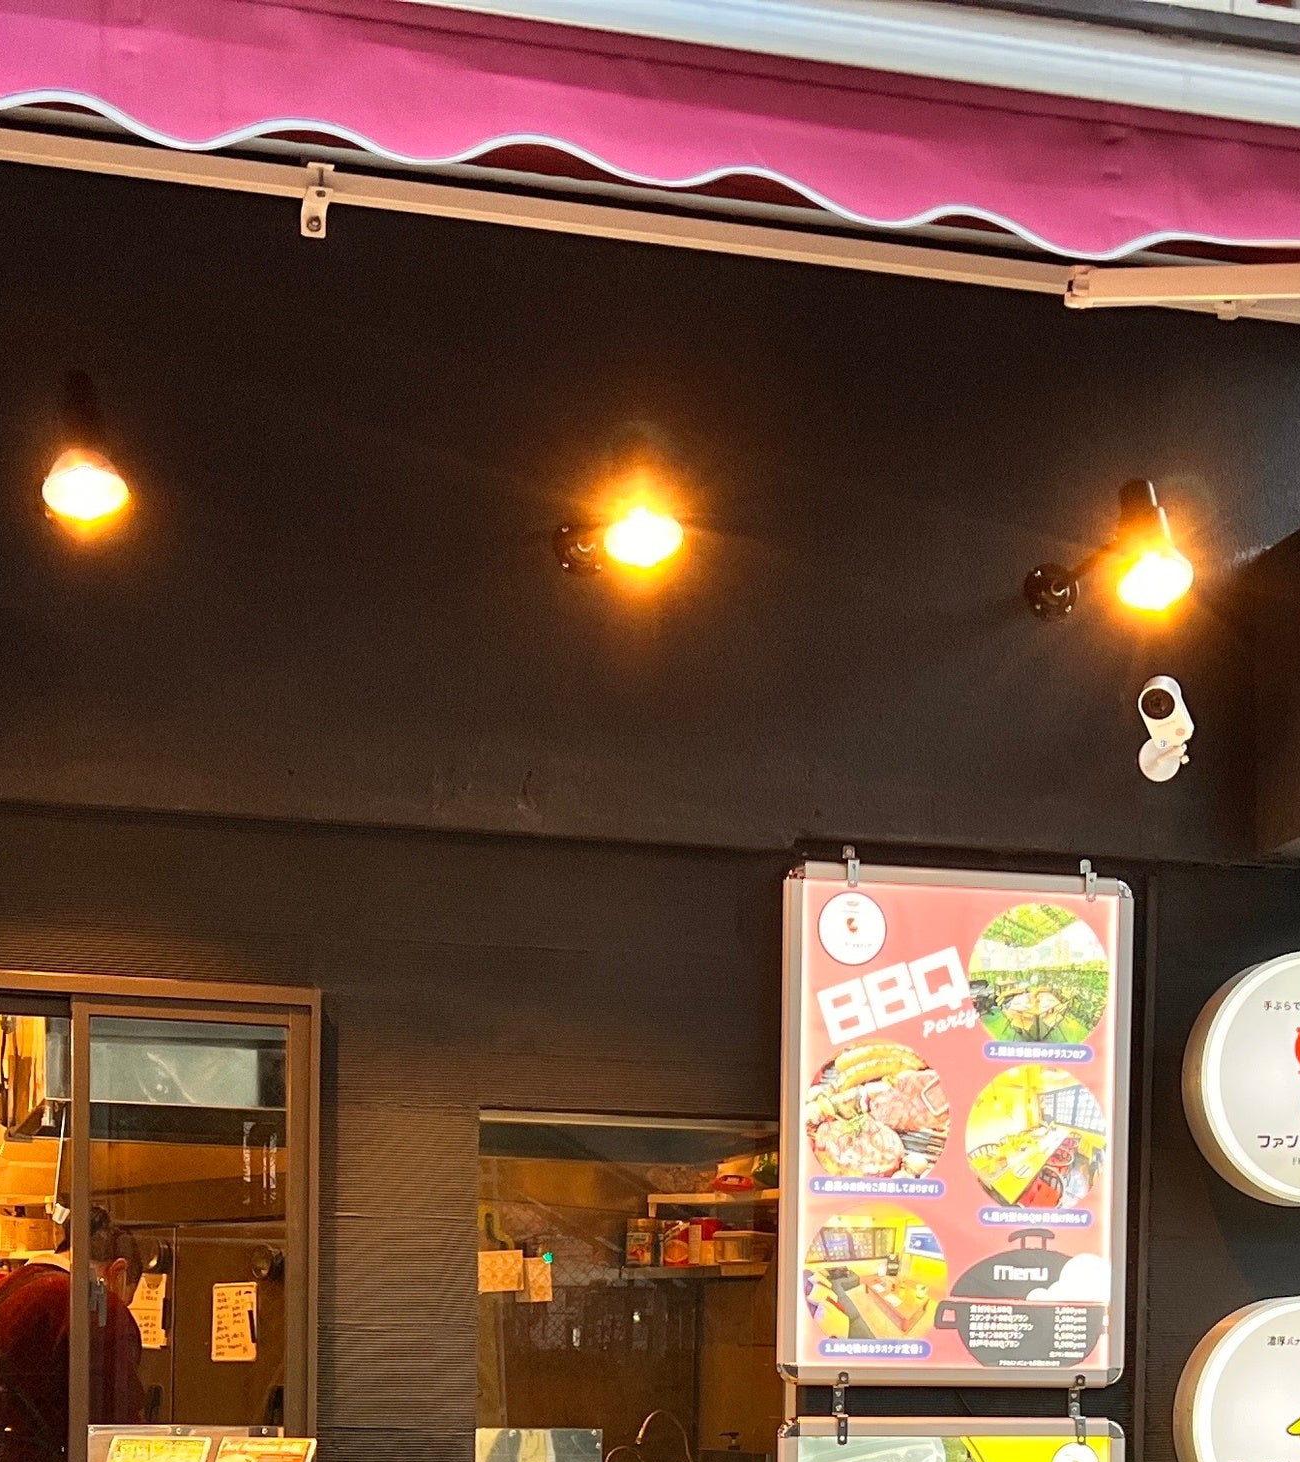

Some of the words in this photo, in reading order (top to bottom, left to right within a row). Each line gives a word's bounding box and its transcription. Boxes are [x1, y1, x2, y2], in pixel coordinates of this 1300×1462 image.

[817, 946, 970, 1045] BBQ
[922, 1008, 980, 1038] Party
[993, 1265, 1048, 1281] Menu
